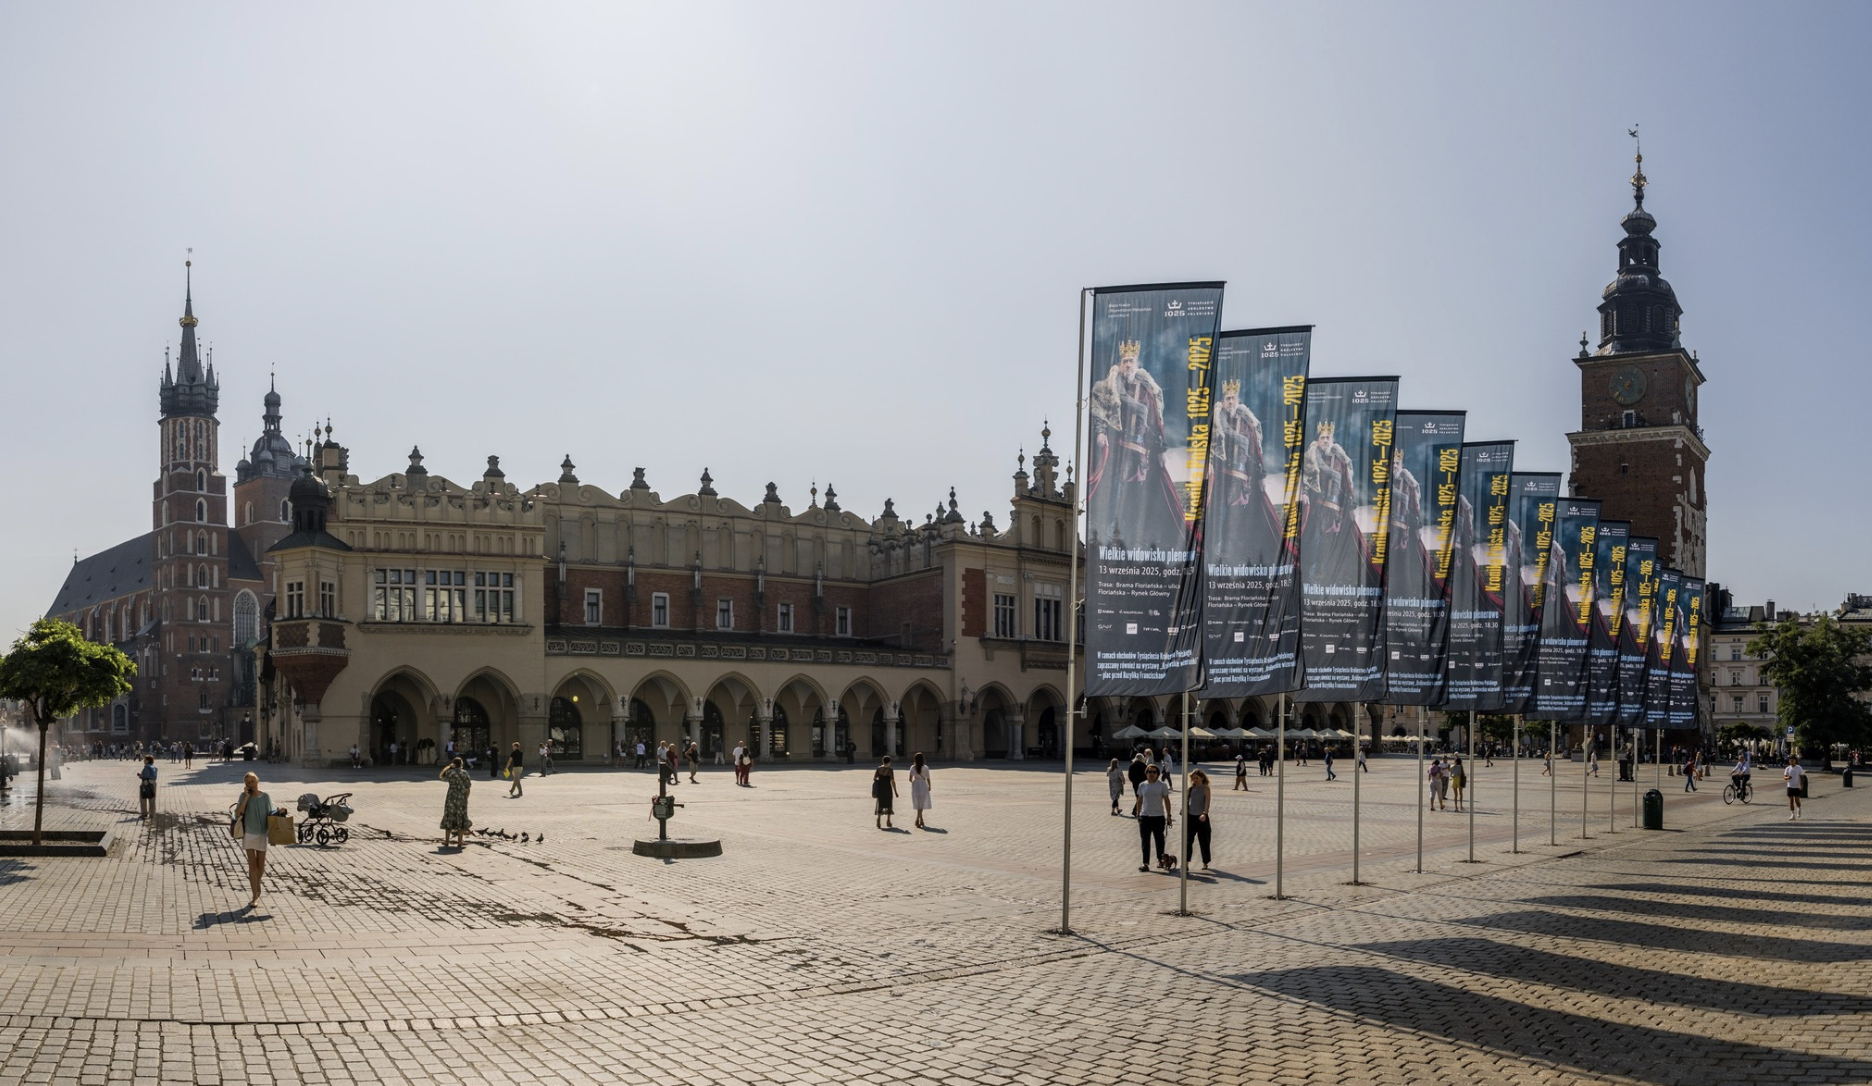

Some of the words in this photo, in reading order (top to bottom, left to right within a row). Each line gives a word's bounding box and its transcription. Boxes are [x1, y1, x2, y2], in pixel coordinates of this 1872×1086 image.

[1186, 424, 1208, 470] Polska
[1487, 528, 1503, 558] Polska
[1099, 546, 1125, 560] Wielkie
[1127, 547, 1166, 561] widowisko
[1099, 566, 1107, 574] 13
[1109, 566, 1139, 575] września
[1142, 567, 1161, 577] 2025,
[1163, 567, 1181, 577] godz.
[1208, 564, 1231, 576] Wielkie
[1233, 564, 1267, 576] widowisko
[1485, 560, 1502, 592] Kronika
[1303, 583, 1324, 595] Wielkie
[1325, 584, 1356, 595] widowisko
[1393, 596, 1419, 607] widowisko
[1473, 610, 1499, 620] plenerowe
